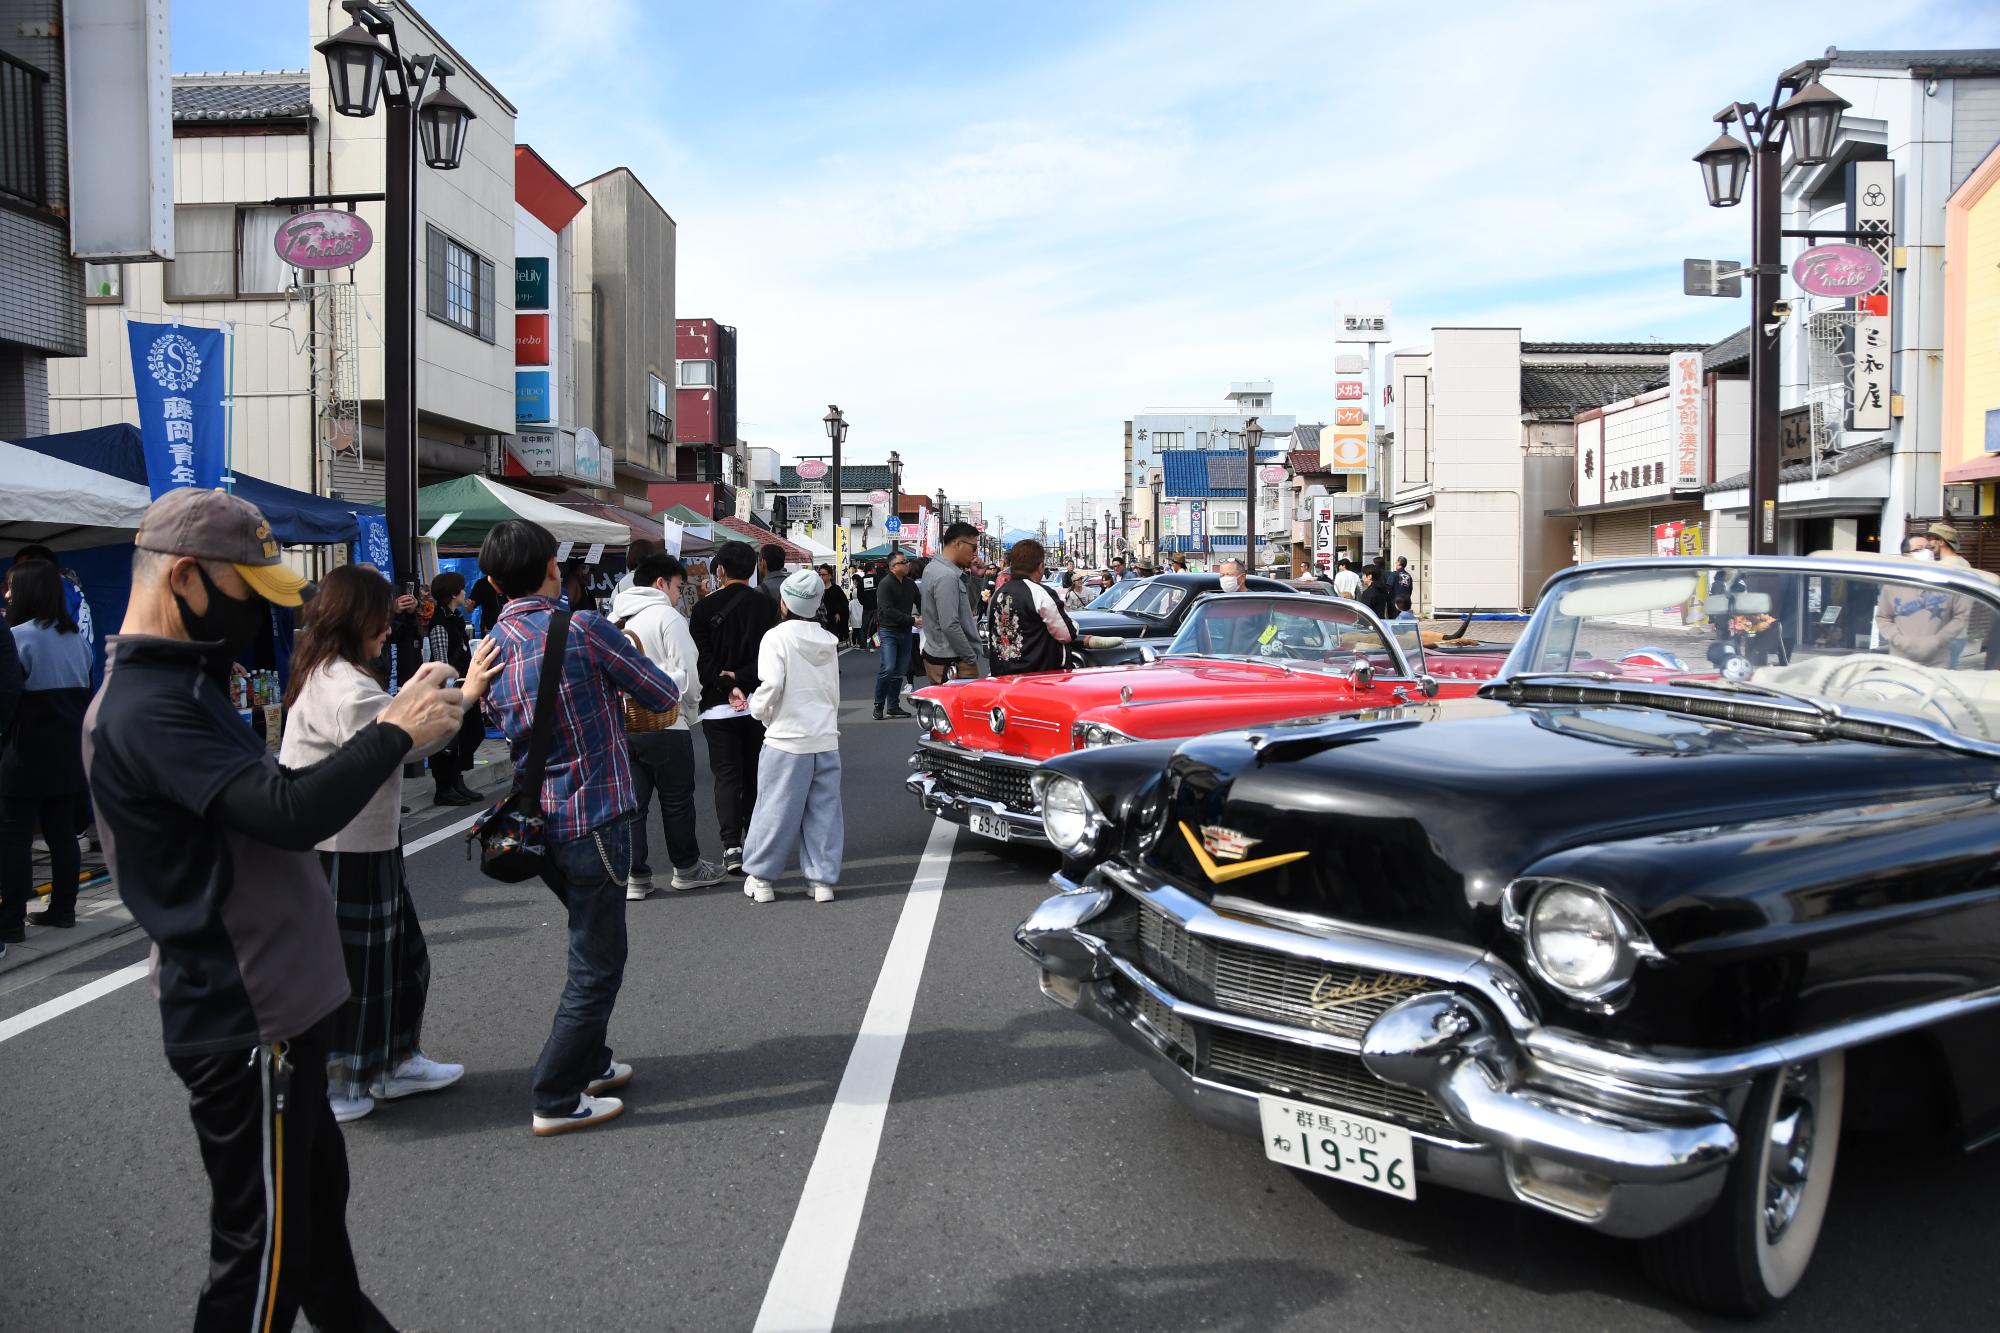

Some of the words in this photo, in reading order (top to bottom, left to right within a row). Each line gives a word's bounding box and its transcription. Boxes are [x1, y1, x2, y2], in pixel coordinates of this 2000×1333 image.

[1859, 328, 1884, 412] 三和屋
[1337, 384, 1361, 397] メガネ
[1337, 411, 1360, 422] トケイ
[1677, 384, 1700, 476] 小太郎の漢方薬
[163, 397, 197, 487] 藤岡青年
[1609, 461, 1664, 491] 大和屋薬局
[1318, 510, 1331, 547] エバラ
[979, 816, 1006, 838] 69-60
[1311, 973, 1427, 1009] Cadillac
[1296, 1109, 1376, 1144] 群馬330
[1273, 1135, 1291, 1152] ね
[1301, 1132, 1406, 1190] 19-56
